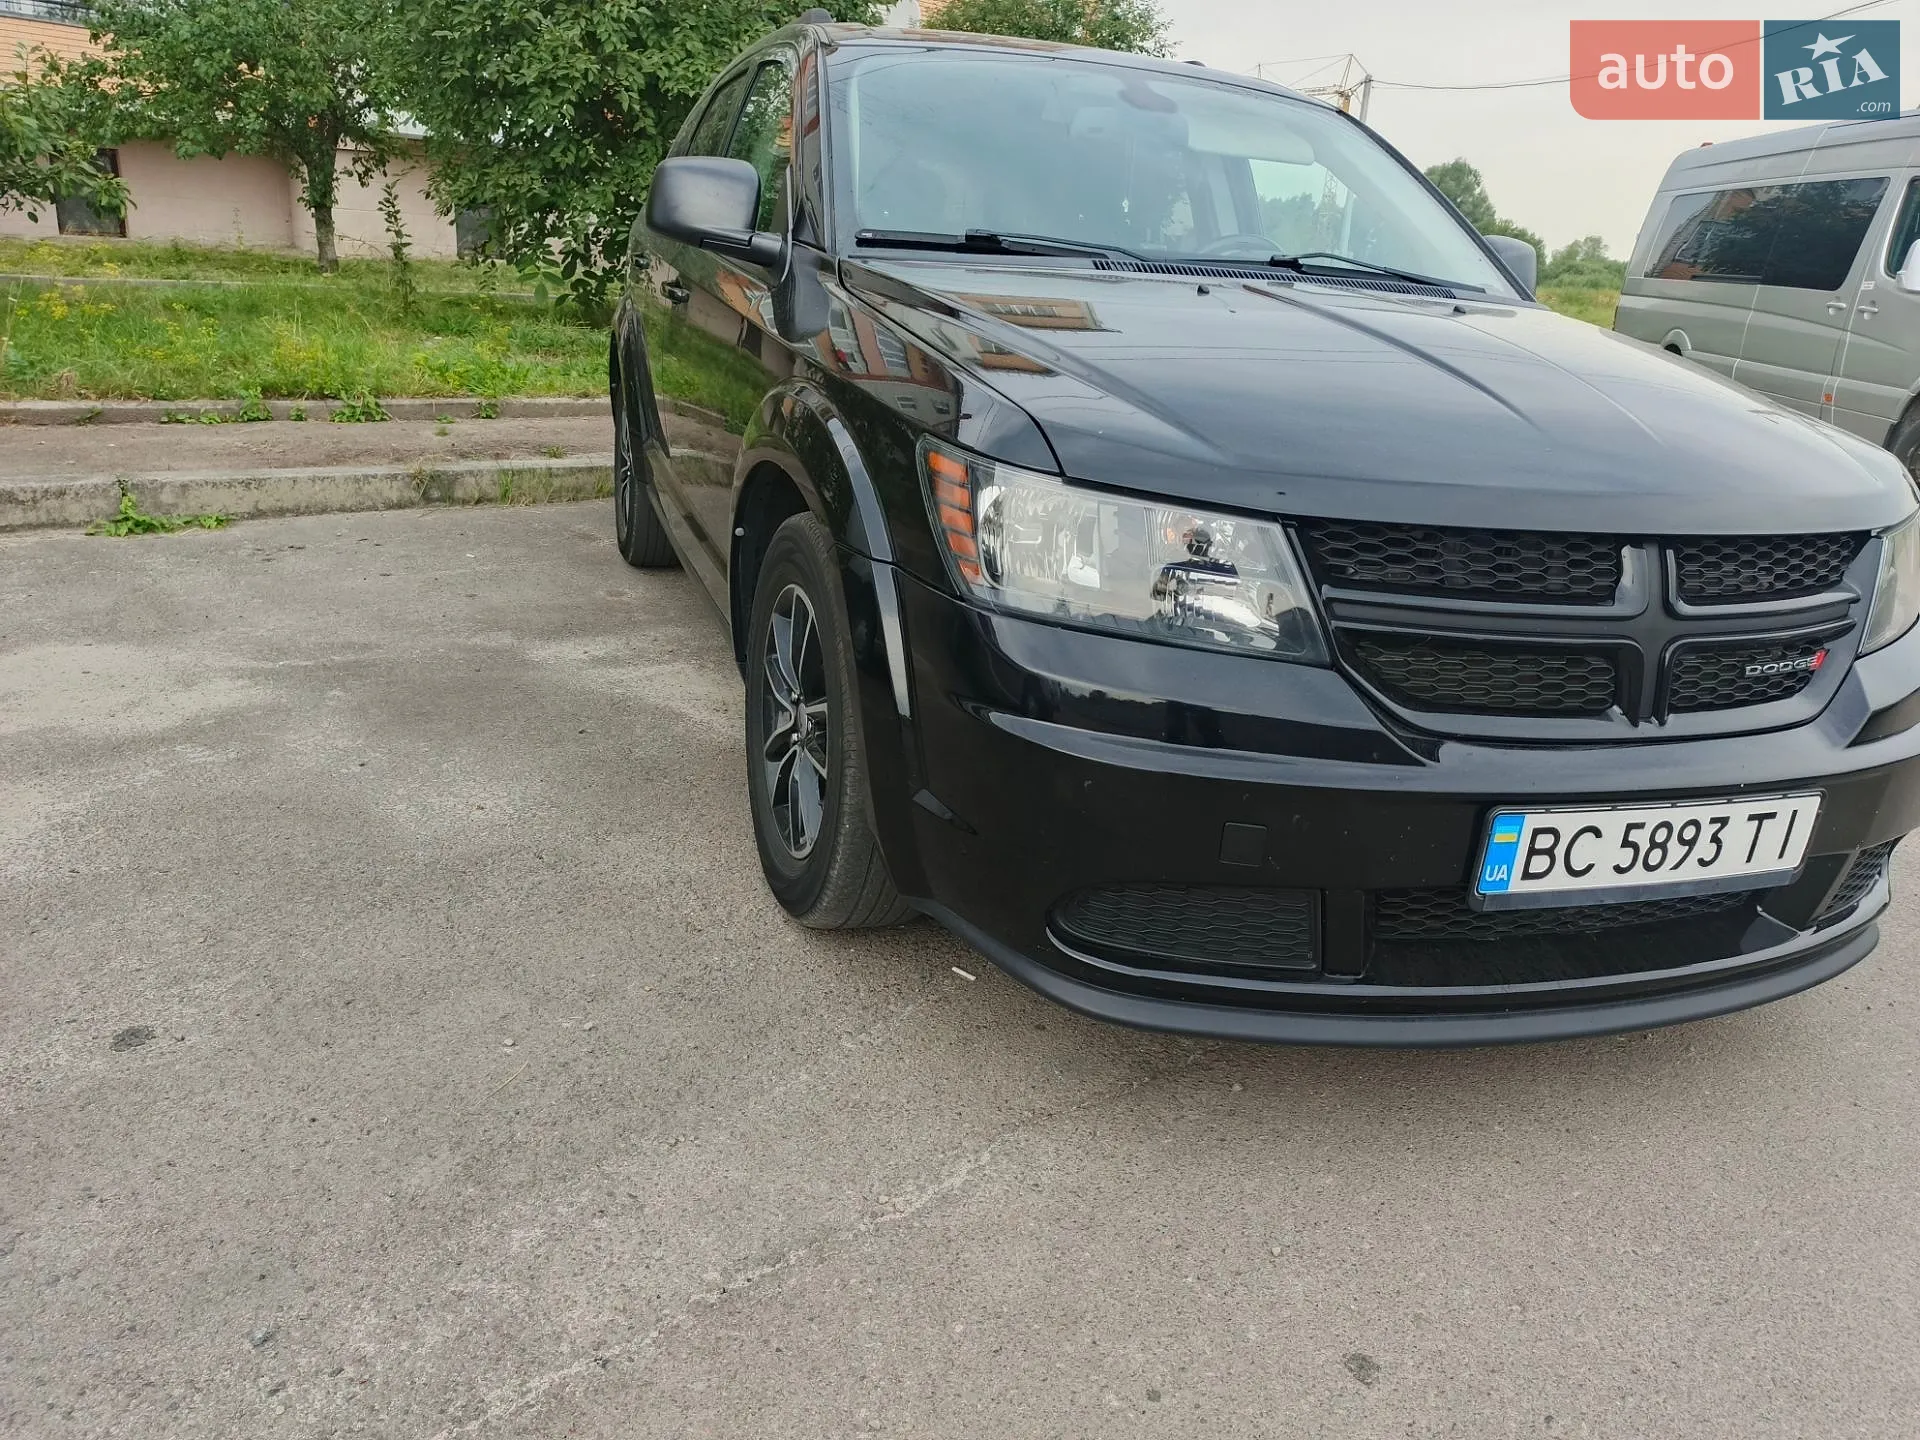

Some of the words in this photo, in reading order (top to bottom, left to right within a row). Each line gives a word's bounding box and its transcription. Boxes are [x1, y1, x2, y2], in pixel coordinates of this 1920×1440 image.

[1745, 655, 1820, 676] DODGE
[1520, 825, 1603, 881] BC
[1612, 815, 1731, 874] 5893
[1745, 808, 1799, 864] TI
[1485, 864, 1508, 881] UA
